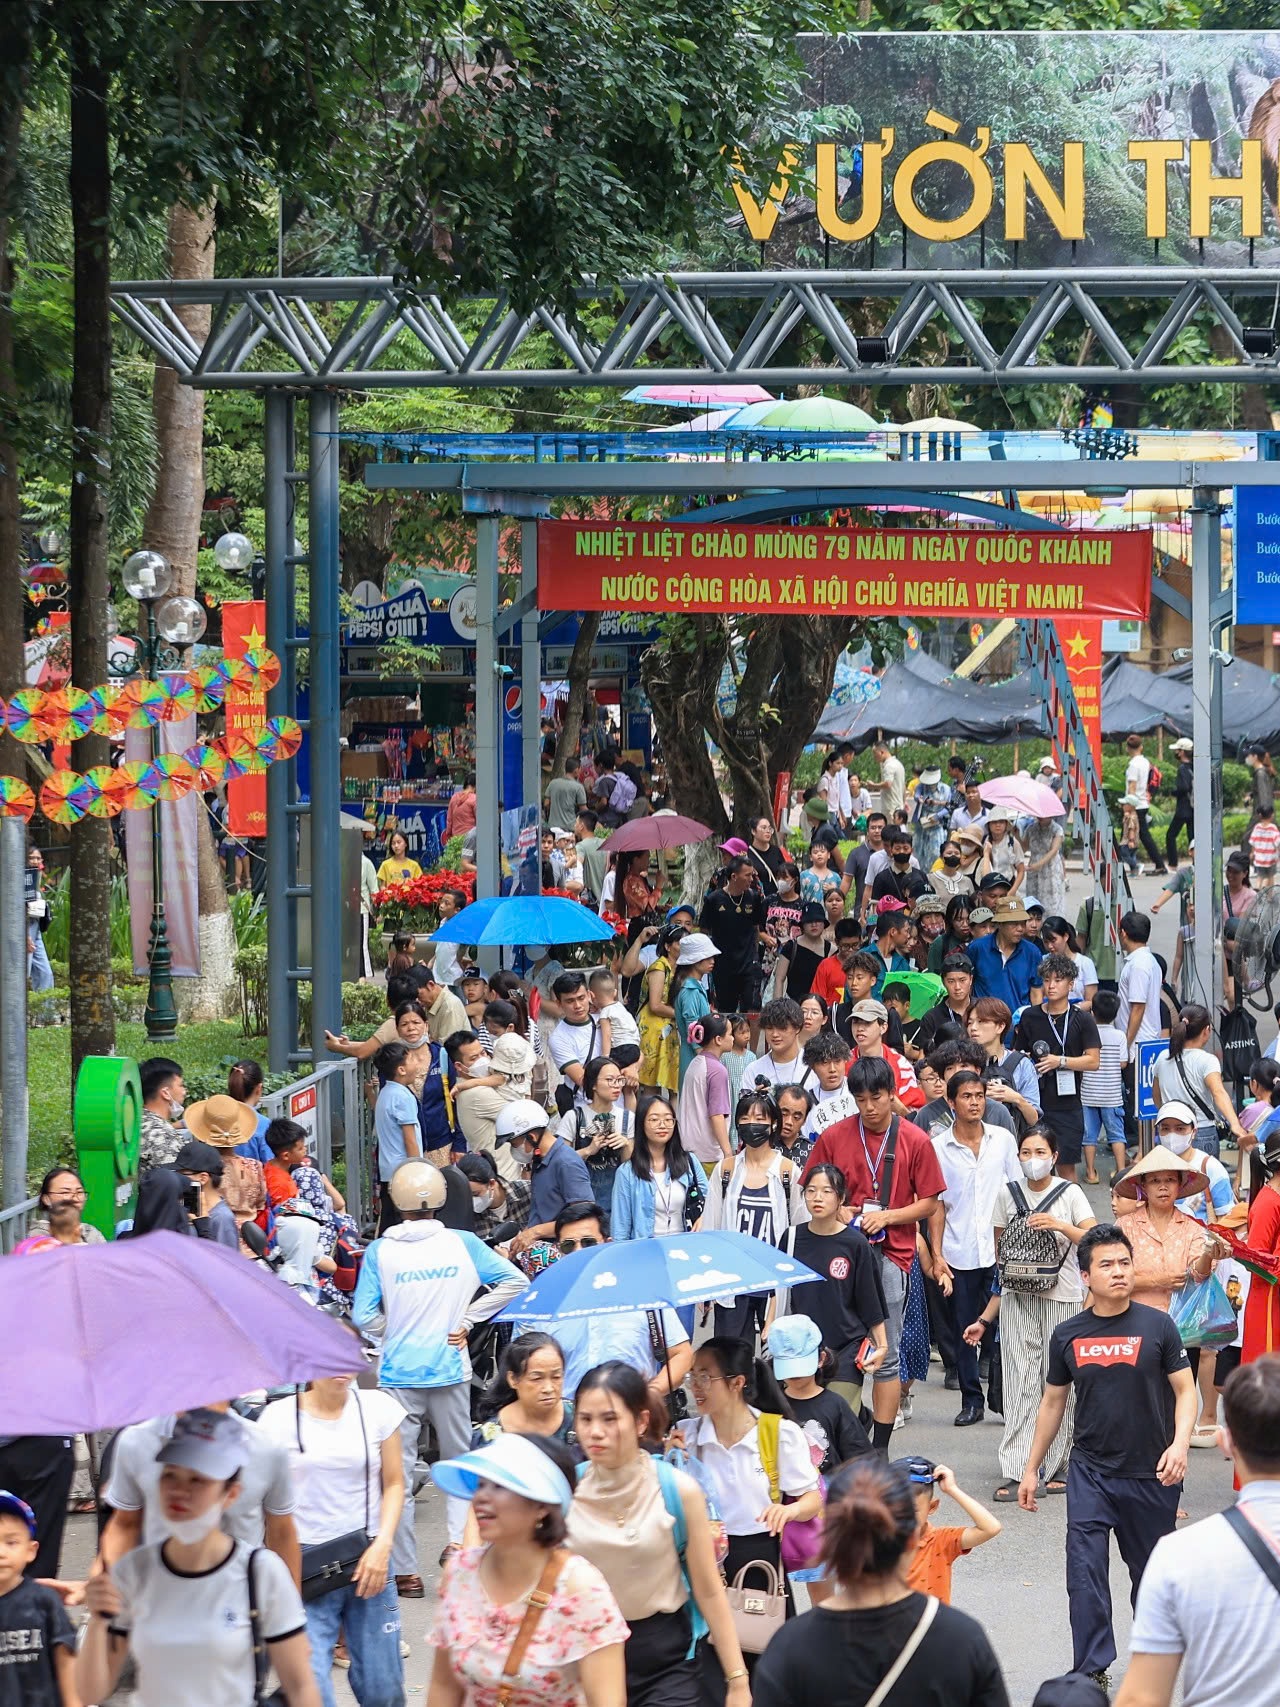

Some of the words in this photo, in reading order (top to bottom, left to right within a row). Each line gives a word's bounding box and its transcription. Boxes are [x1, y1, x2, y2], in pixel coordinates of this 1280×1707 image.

[719, 108, 1086, 242] VƯỜN
[575, 526, 637, 562] NHIỆT
[642, 528, 686, 563] LIỆT
[691, 529, 748, 559] CHÀO
[753, 529, 818, 560] MỪNG
[824, 535, 849, 560] 79
[856, 531, 906, 562] NĂM
[912, 533, 971, 562] NGÀY
[975, 531, 1033, 567] QUỐC
[1038, 534, 1112, 566] KHÁNH
[388, 591, 427, 618] QUÁ
[601, 571, 659, 602] NƯỚC
[665, 572, 723, 608] CỘNG
[729, 572, 772, 604] HÒA
[778, 574, 807, 604] XÃ
[813, 574, 848, 610] HỘI
[855, 572, 897, 606] CHỦ
[903, 577, 970, 608] NGHĨA
[975, 578, 1021, 614] VIỆT
[1026, 584, 1084, 610] NAM!
[349, 620, 383, 638] PEPSI
[399, 810, 427, 834] UÁ
[1142, 1052, 1155, 1088] LỐ
